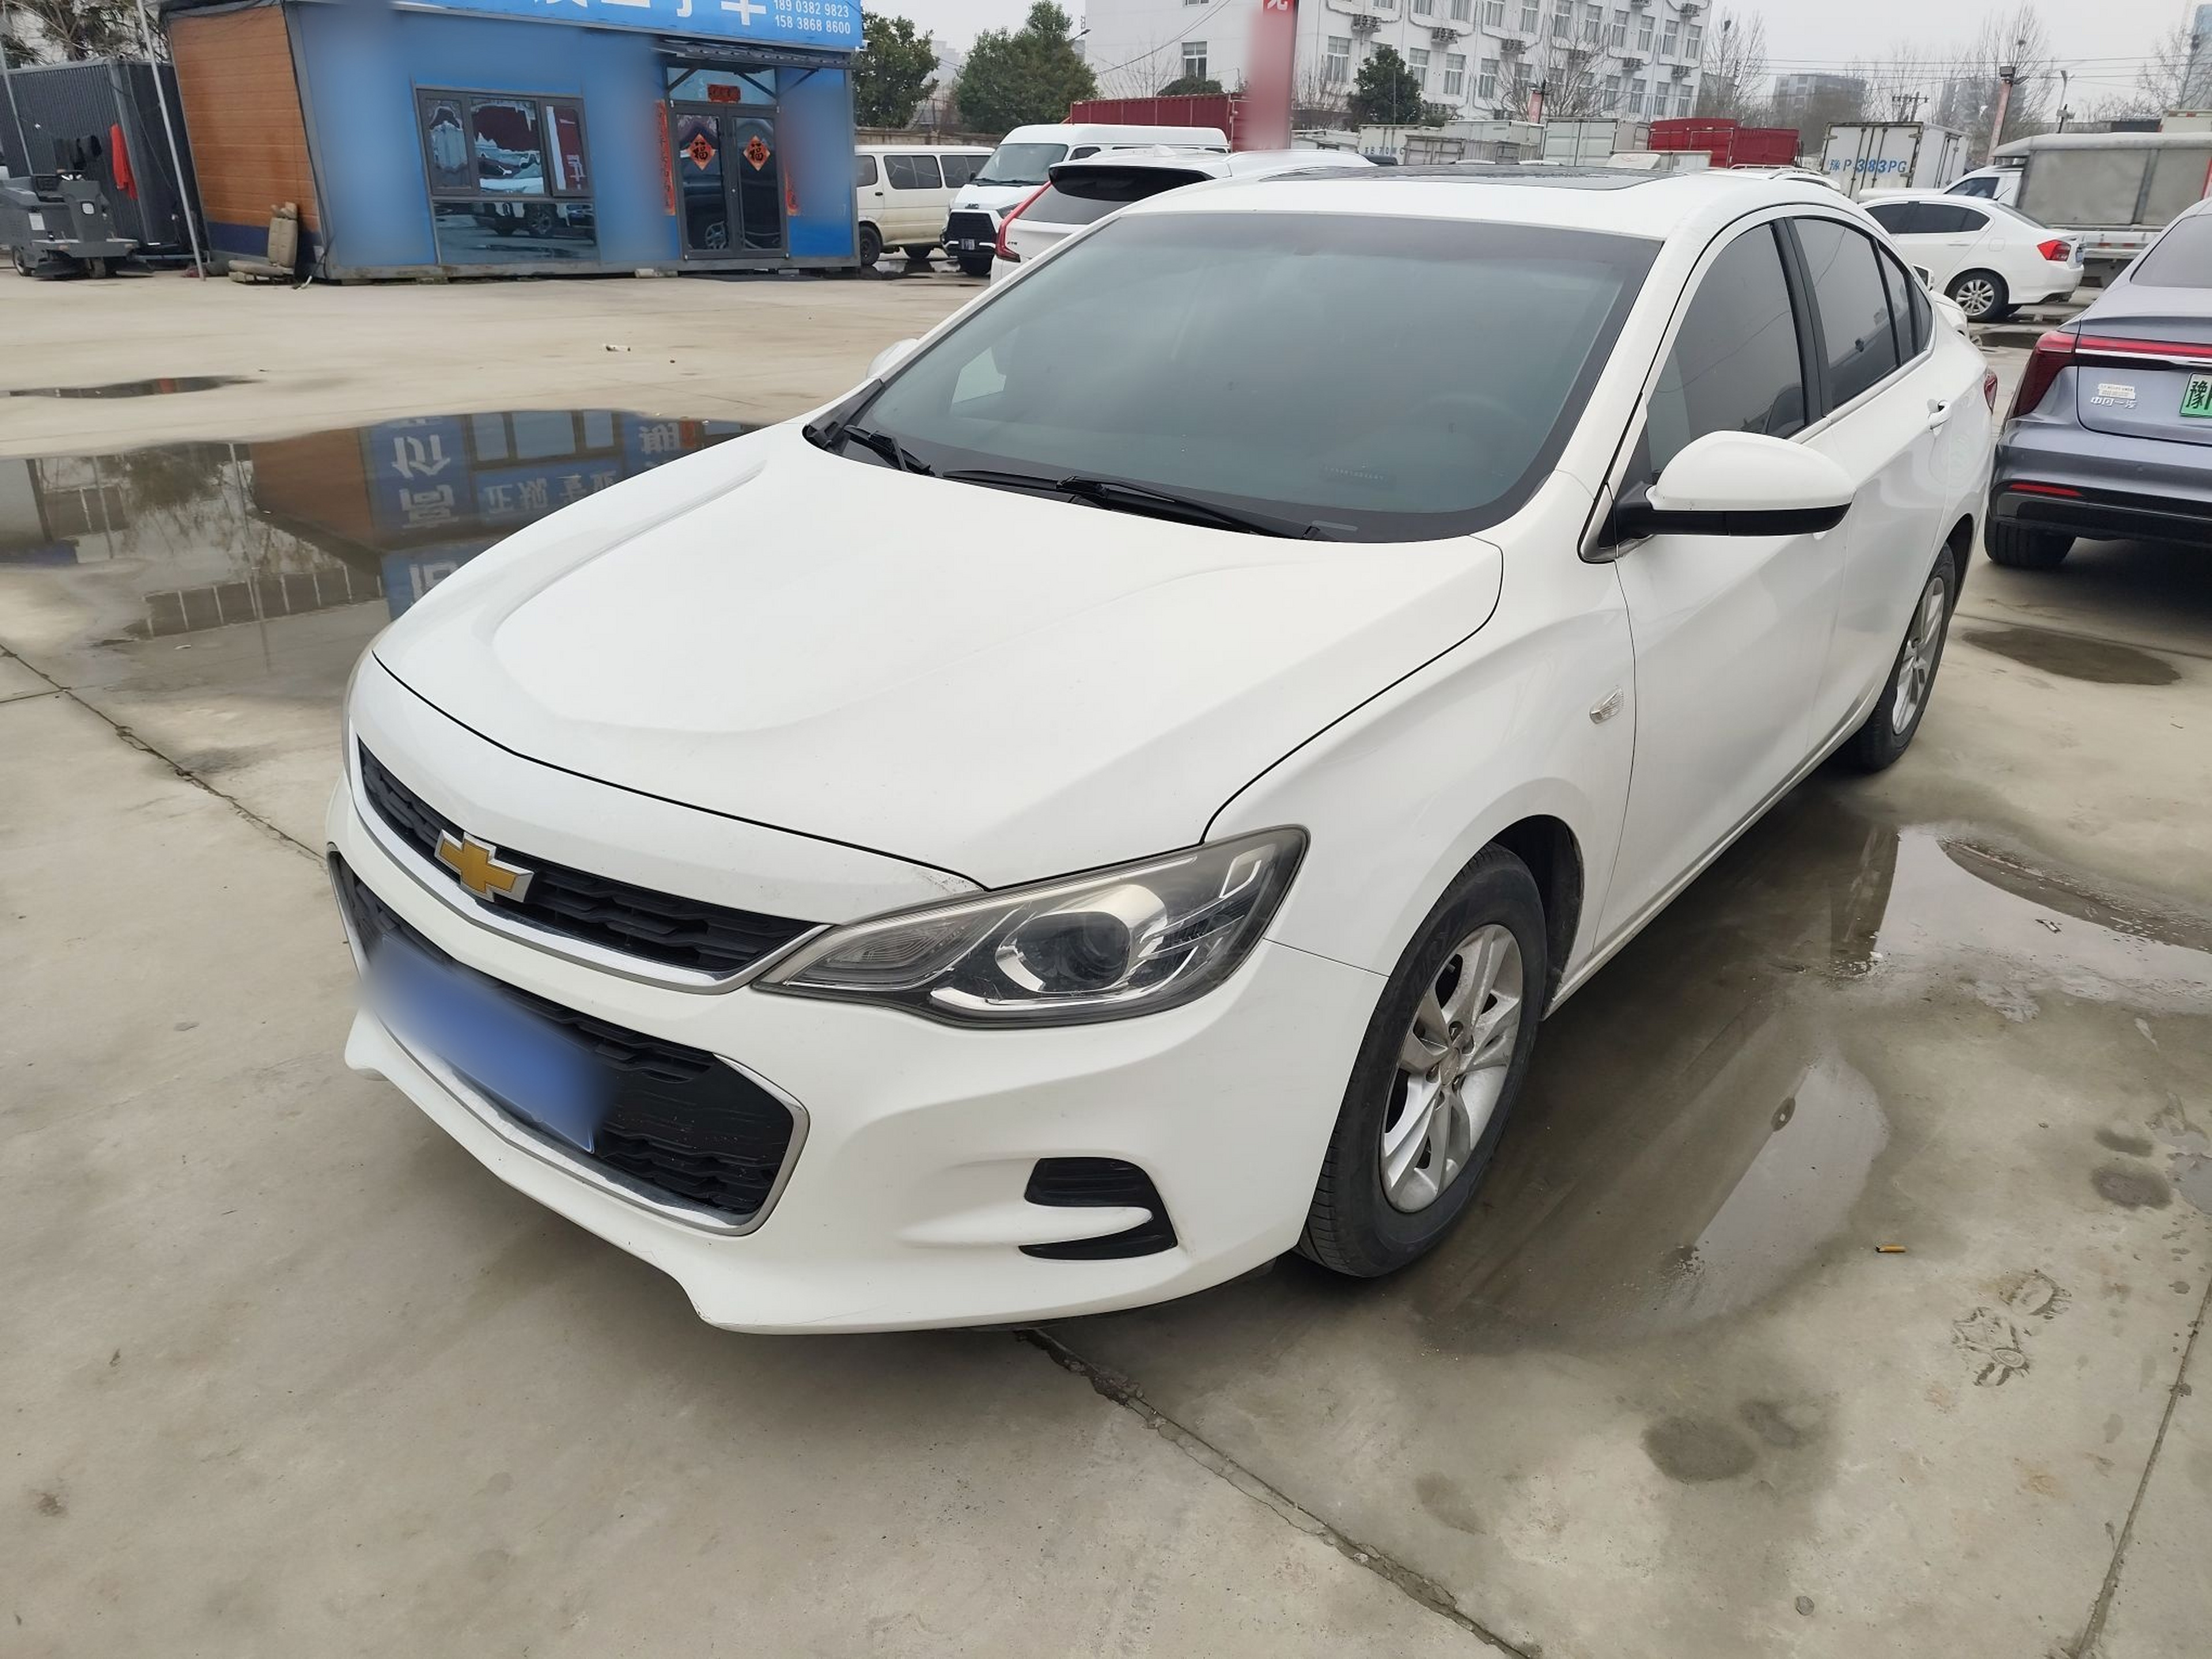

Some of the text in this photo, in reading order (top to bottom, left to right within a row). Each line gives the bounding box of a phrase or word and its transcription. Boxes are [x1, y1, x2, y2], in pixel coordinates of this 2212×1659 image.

[775, 0, 849, 18] 189 0382 9823
[775, 14, 851, 35] 158 3868 8600
